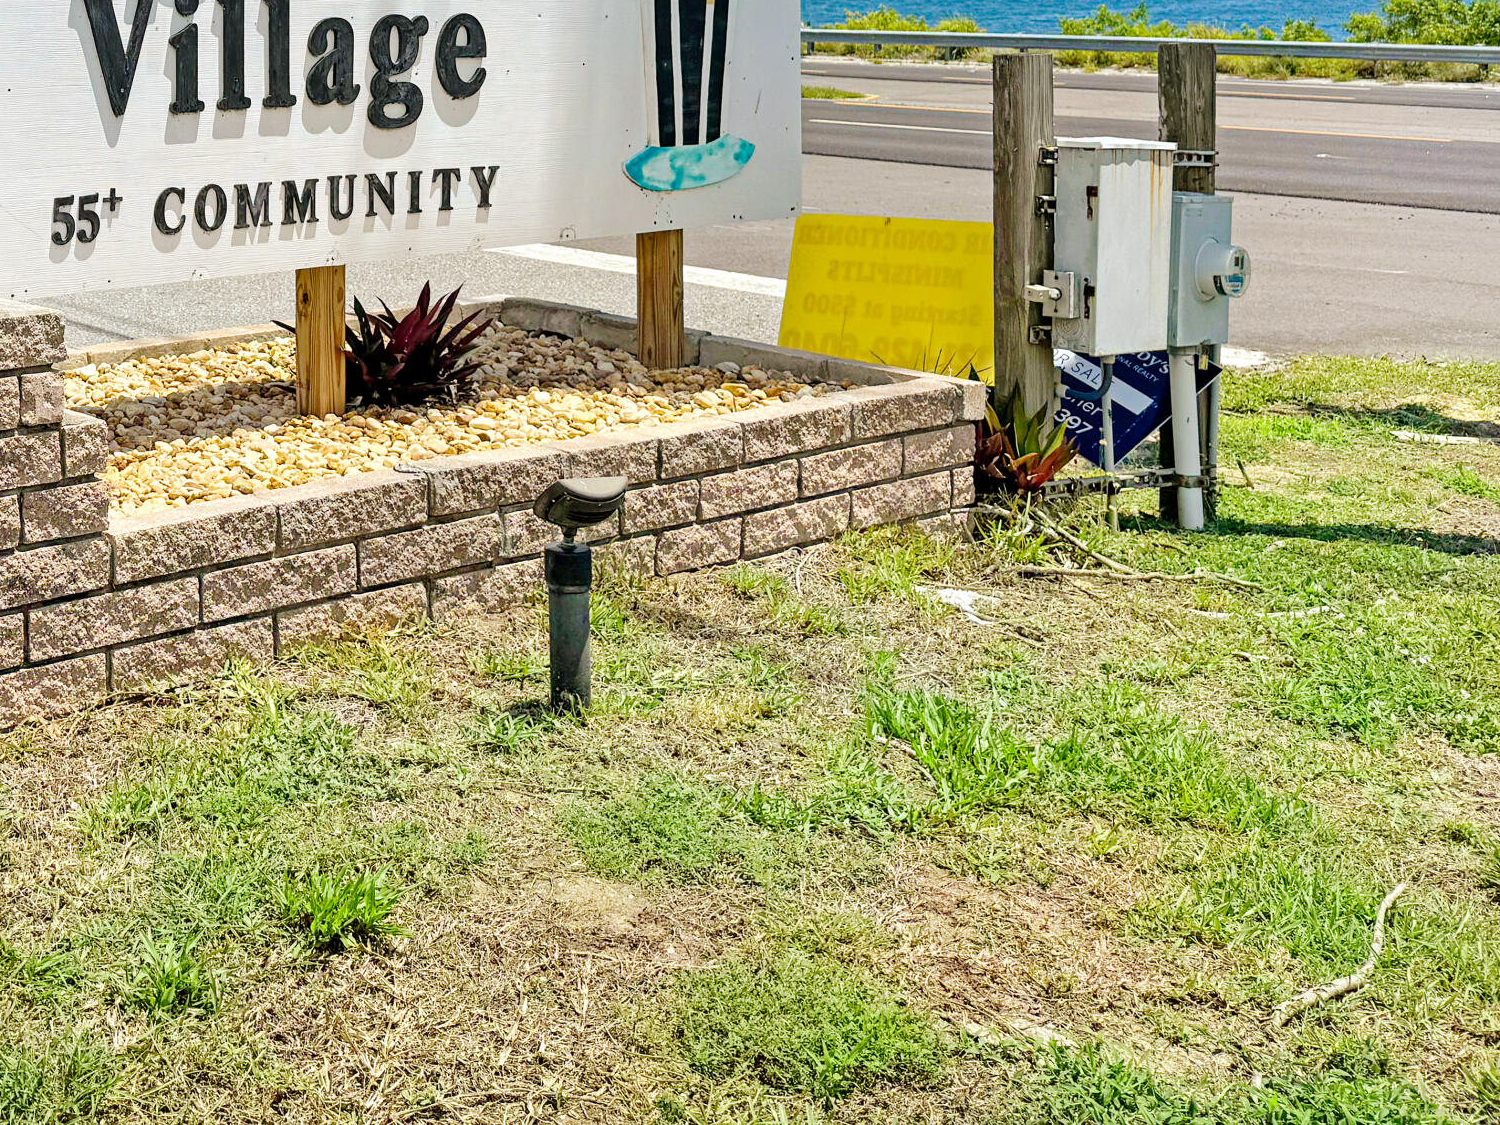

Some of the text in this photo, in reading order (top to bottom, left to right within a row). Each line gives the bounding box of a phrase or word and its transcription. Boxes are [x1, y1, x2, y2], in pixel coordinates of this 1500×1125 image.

[51, 165, 501, 246] 55+ COMMUNITY
[1132, 364, 1160, 382] REALTY
[1053, 409, 1094, 434] 397
